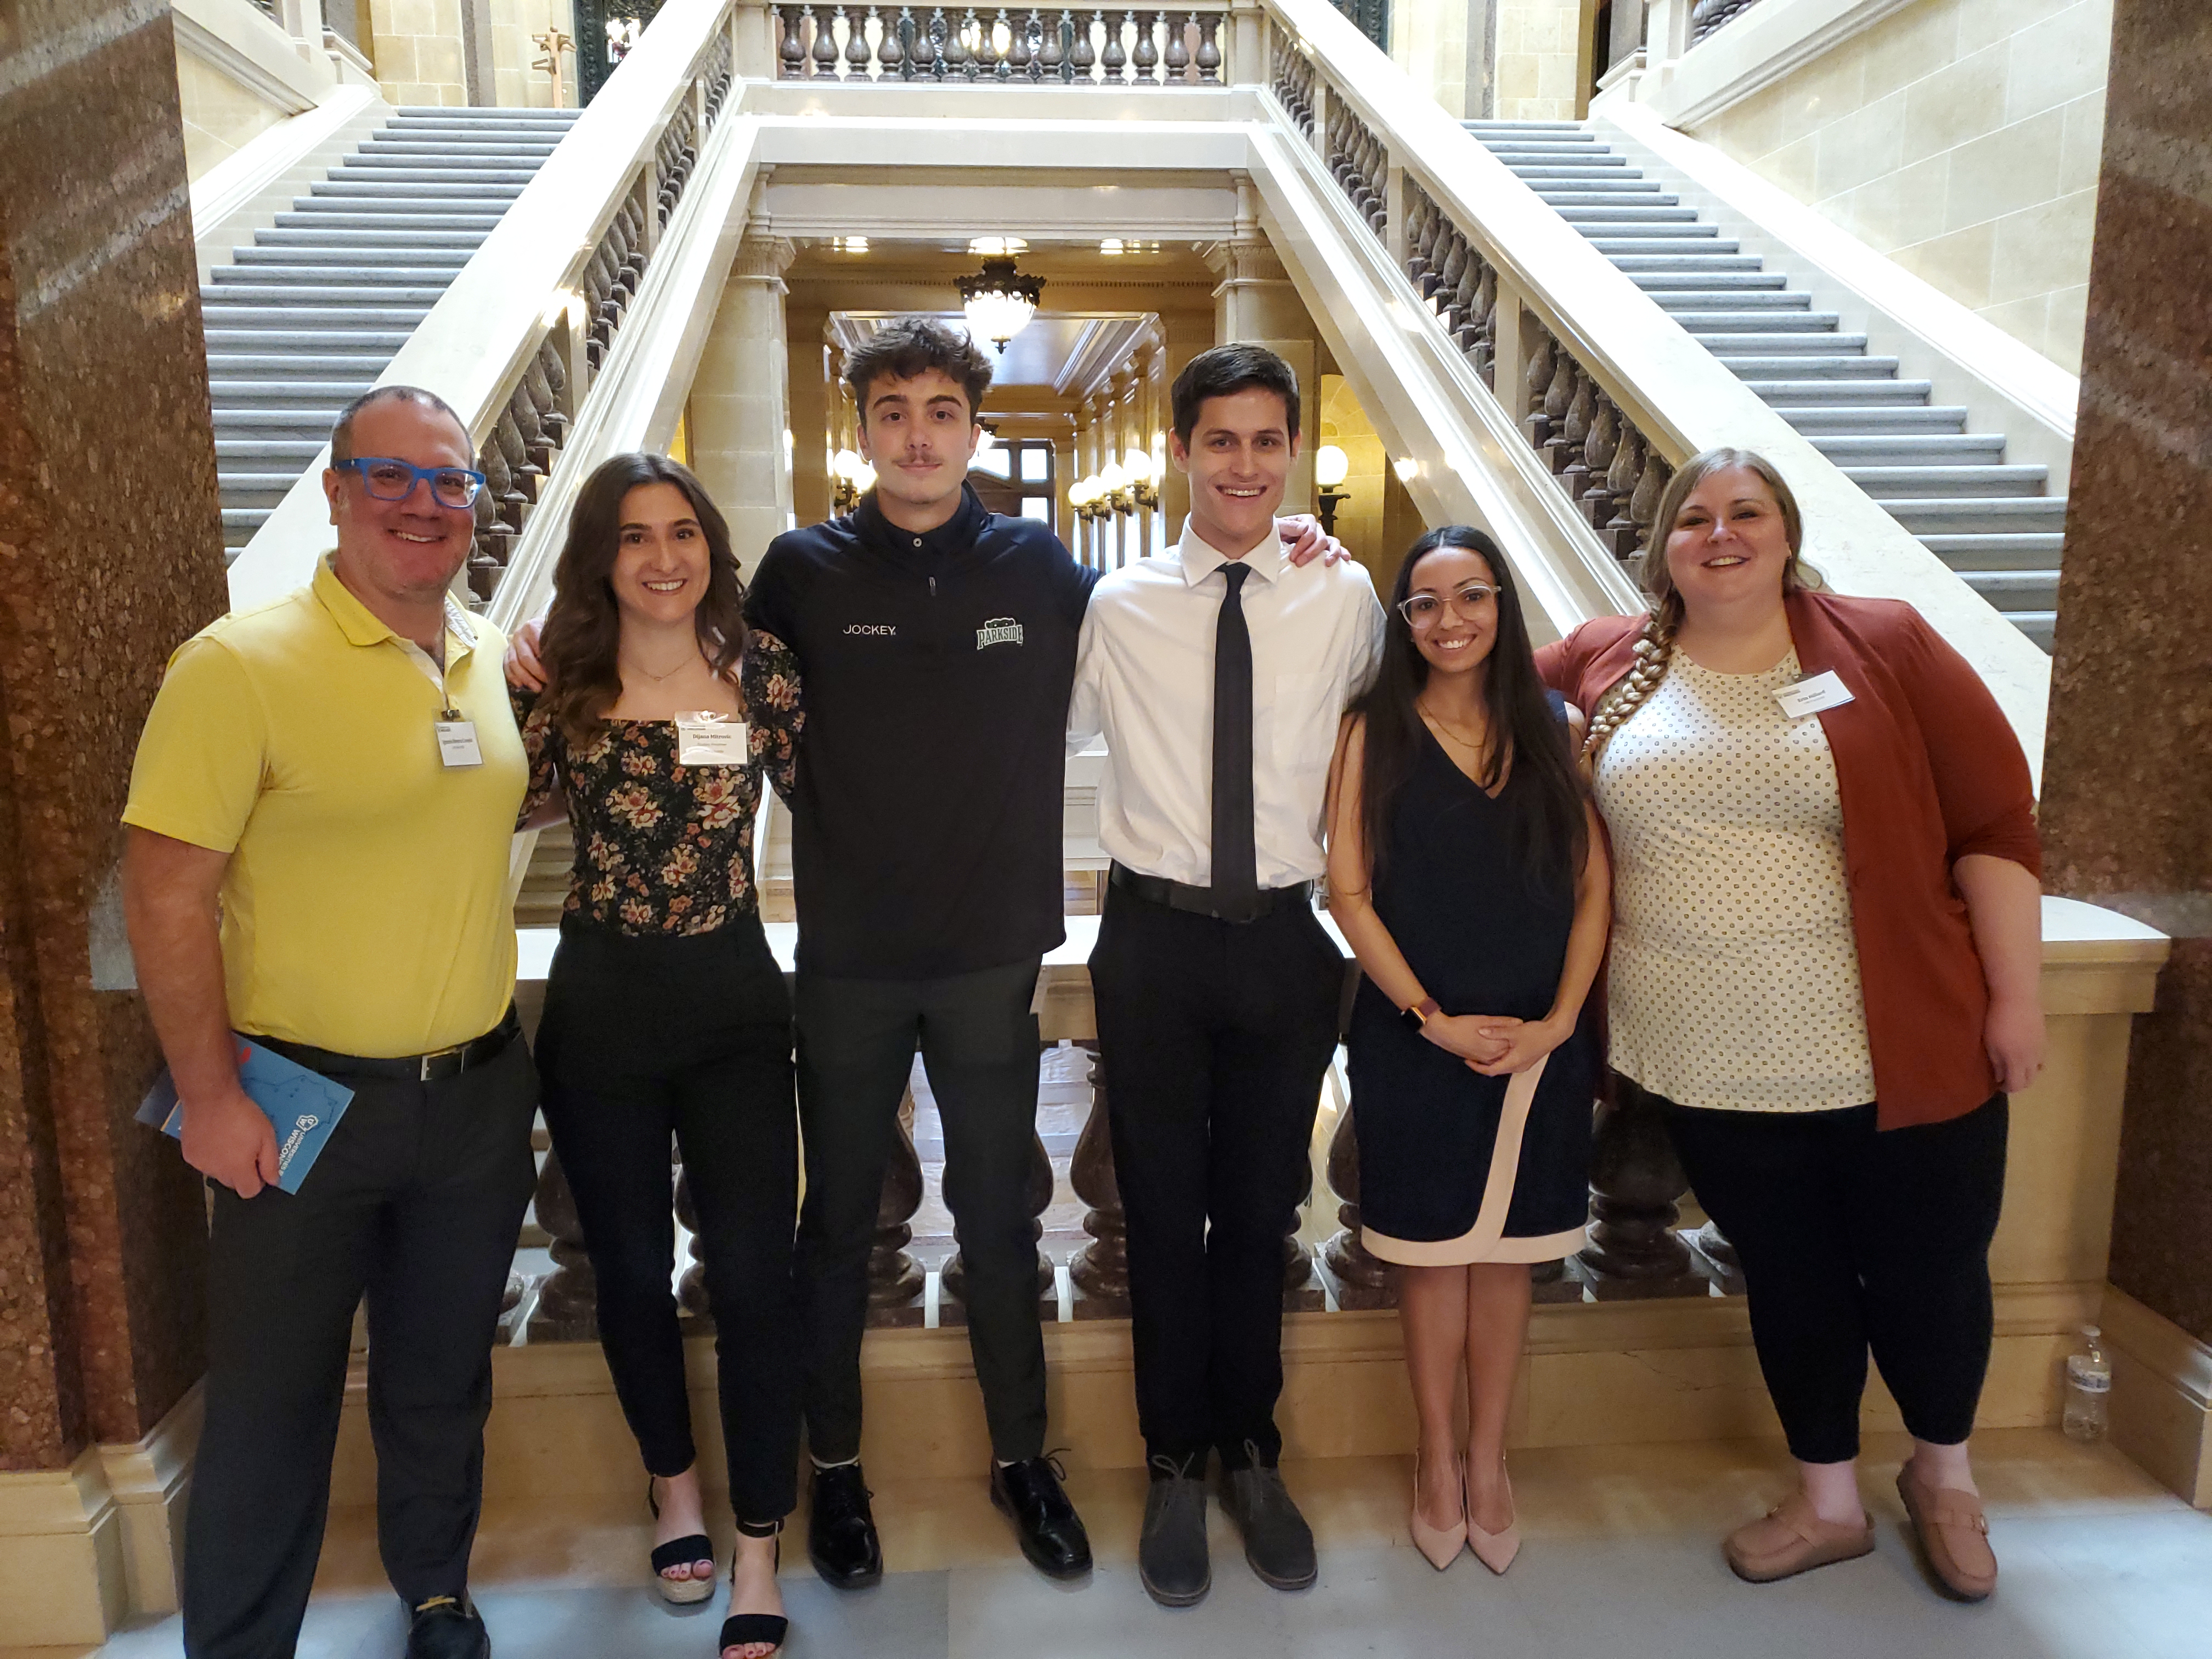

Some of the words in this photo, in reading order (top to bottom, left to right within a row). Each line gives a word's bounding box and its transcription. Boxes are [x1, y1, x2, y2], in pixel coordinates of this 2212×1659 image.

[843, 624, 896, 635] JOCKEY
[978, 625, 1023, 648] PARKSIDE
[281, 1132, 305, 1170] UNIVERSITIES
